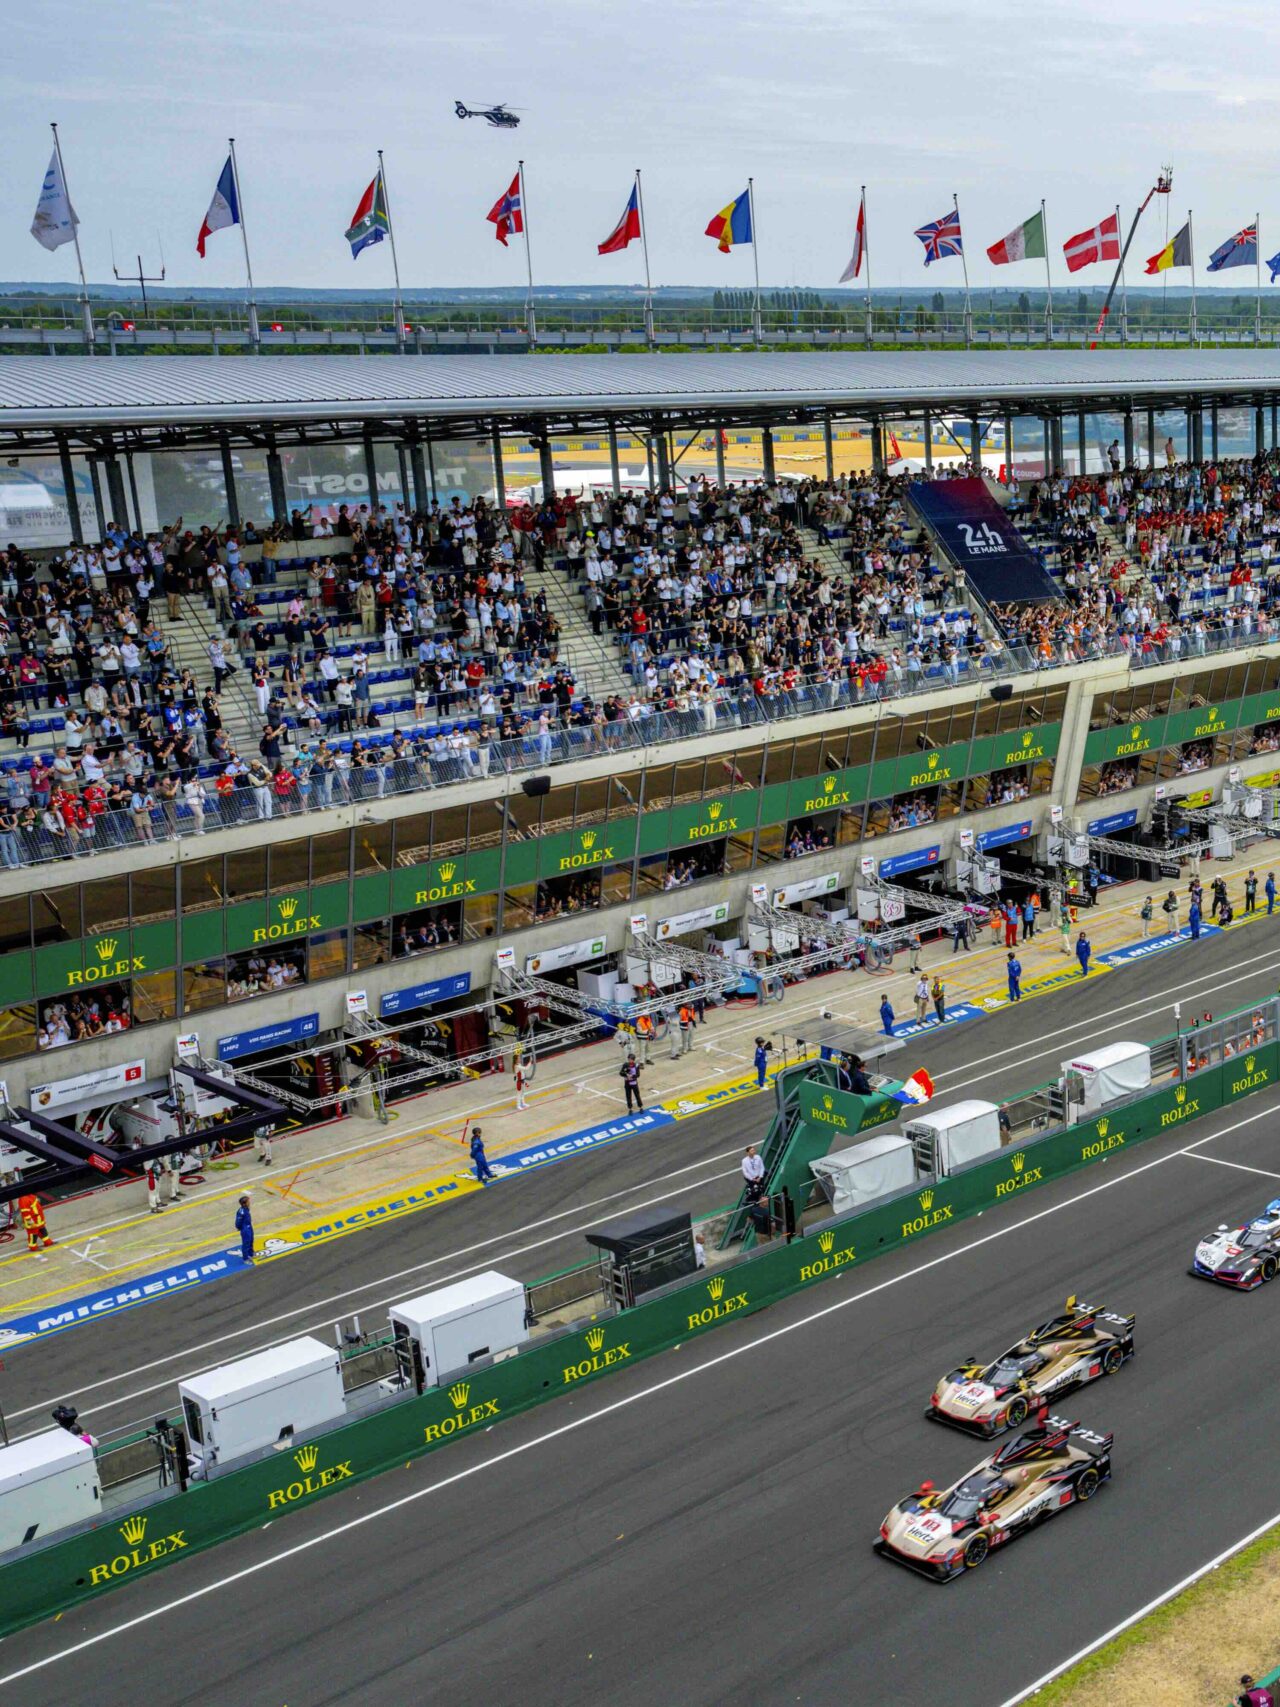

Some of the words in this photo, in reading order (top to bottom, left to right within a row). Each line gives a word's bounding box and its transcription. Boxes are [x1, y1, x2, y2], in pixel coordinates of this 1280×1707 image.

[957, 522, 1003, 547] 24h
[969, 547, 980, 555] LE
[1195, 721, 1225, 736] ROLEX
[1006, 746, 1043, 763] ROLEX
[1117, 739, 1151, 755] ROLEX
[910, 768, 950, 786] ROLEX
[805, 792, 849, 812] ROLEX
[689, 818, 738, 840] ROLEX
[559, 847, 614, 870] ROLEX
[415, 880, 477, 905] ROLEX
[253, 915, 321, 943] ROLEX
[67, 956, 146, 986] ROLEX
[303, 1022, 313, 1031] 48
[130, 1070, 136, 1078] 5
[1232, 1070, 1268, 1094] ROLEX
[811, 1107, 848, 1128] ROLEX
[1161, 1101, 1199, 1126] ROLEX
[520, 1115, 655, 1166] MICHELIN
[1082, 1133, 1125, 1159] ROLEX
[996, 1168, 1042, 1197] ROLEX
[302, 1182, 459, 1239] MICHELIN
[902, 1206, 953, 1237] ROLEX
[800, 1247, 855, 1281] ROLEX
[38, 1259, 227, 1331] MICHELIN
[687, 1292, 749, 1329] ROLEX
[563, 1343, 631, 1383] ROLEX
[1055, 1370, 1081, 1388] Hertz
[955, 1393, 979, 1408] Hertz
[424, 1399, 499, 1442] ROLEX
[268, 1461, 353, 1509] ROLEX
[1021, 1500, 1051, 1519] Hertz
[907, 1526, 935, 1542] Hertz
[90, 1531, 187, 1585] ROLEX
